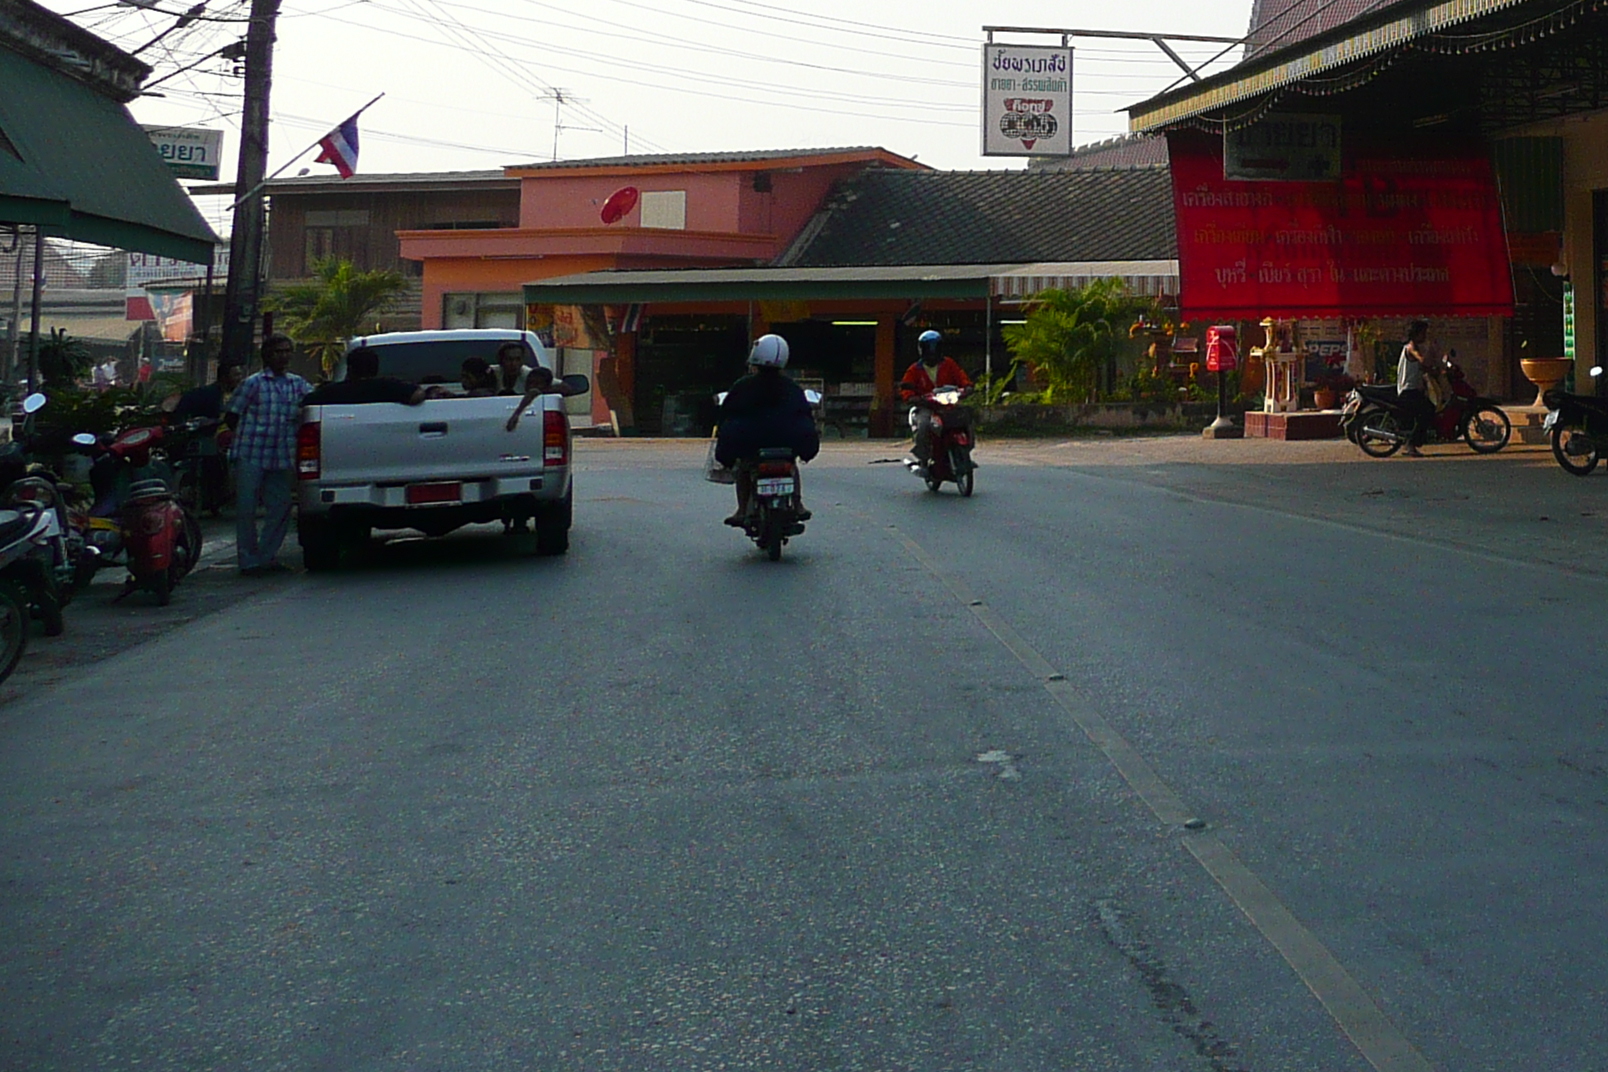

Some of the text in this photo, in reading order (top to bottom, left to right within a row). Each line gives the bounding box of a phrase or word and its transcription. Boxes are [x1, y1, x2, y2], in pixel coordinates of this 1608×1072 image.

[993, 49, 1066, 73] ชัยพรเภสัช
[1258, 260, 1292, 284] เบียร์
[1297, 266, 1322, 289] สุรา
